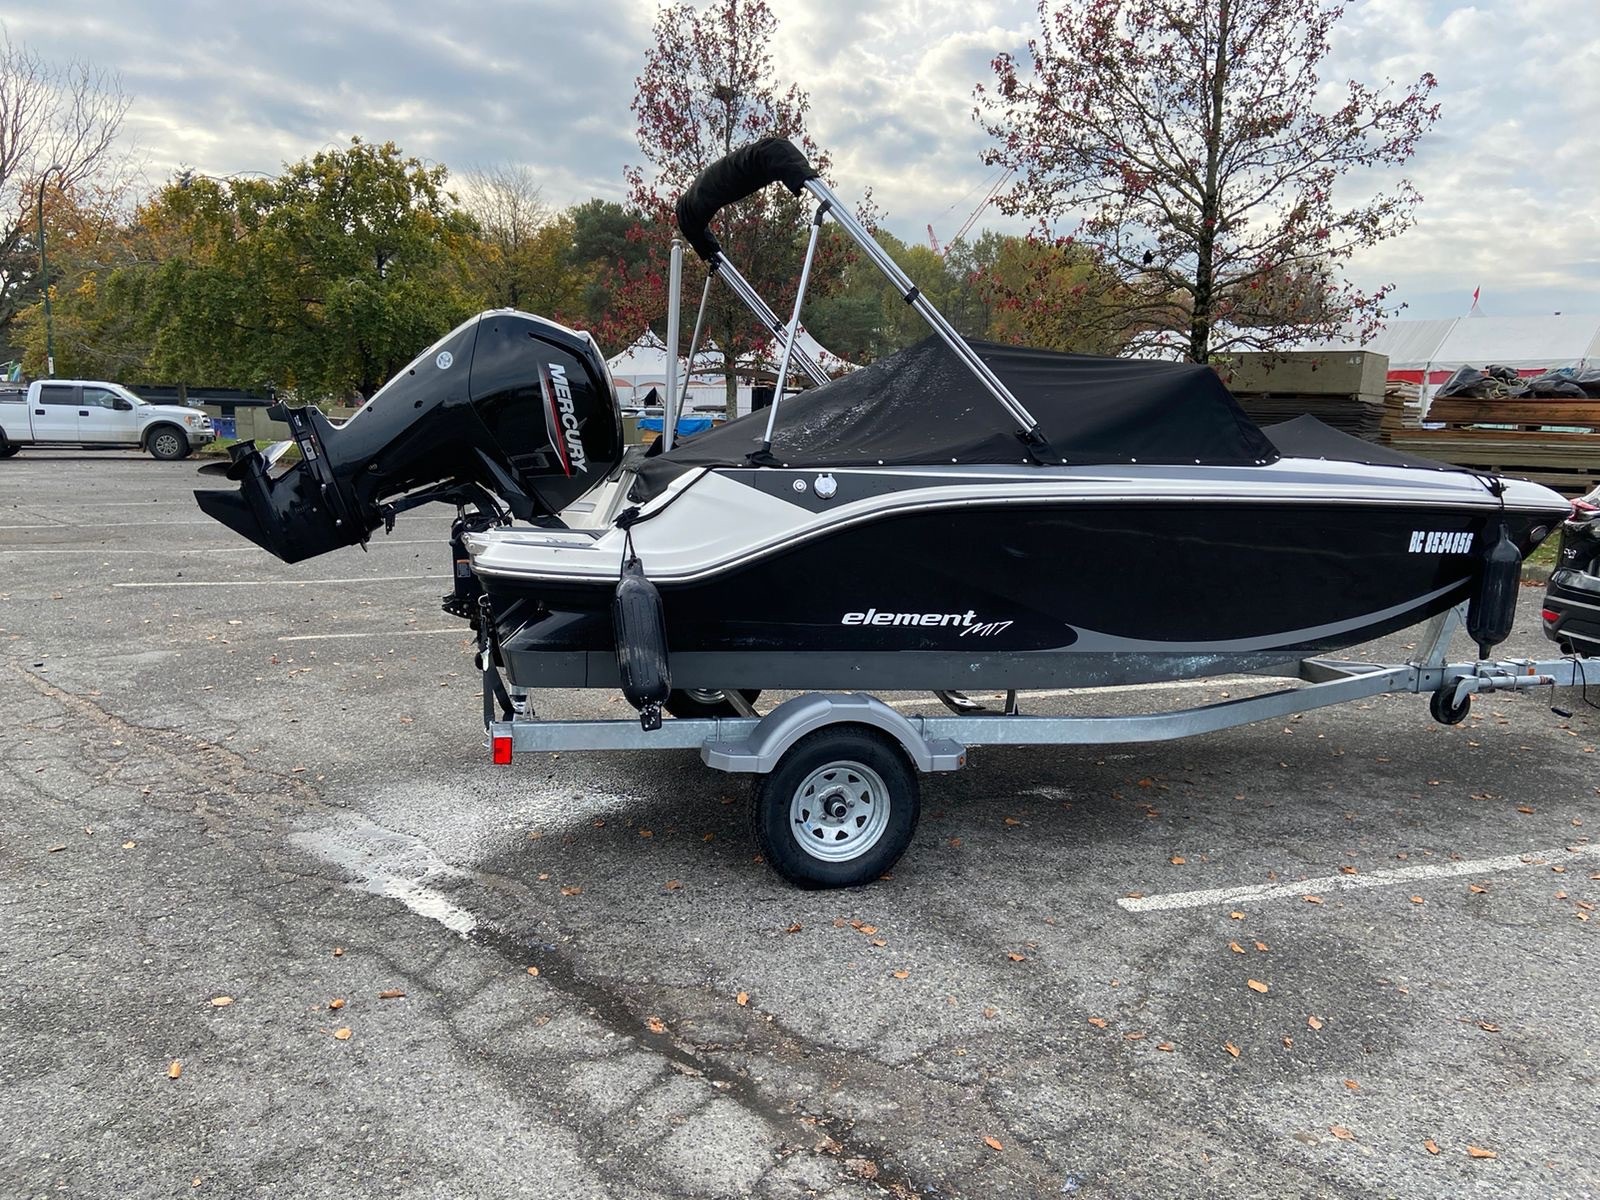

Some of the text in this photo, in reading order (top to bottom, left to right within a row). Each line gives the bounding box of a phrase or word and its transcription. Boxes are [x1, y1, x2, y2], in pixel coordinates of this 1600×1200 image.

[548, 363, 588, 473] MERCURY
[1408, 531, 1474, 554] BC 8534856
[841, 608, 977, 627] element
